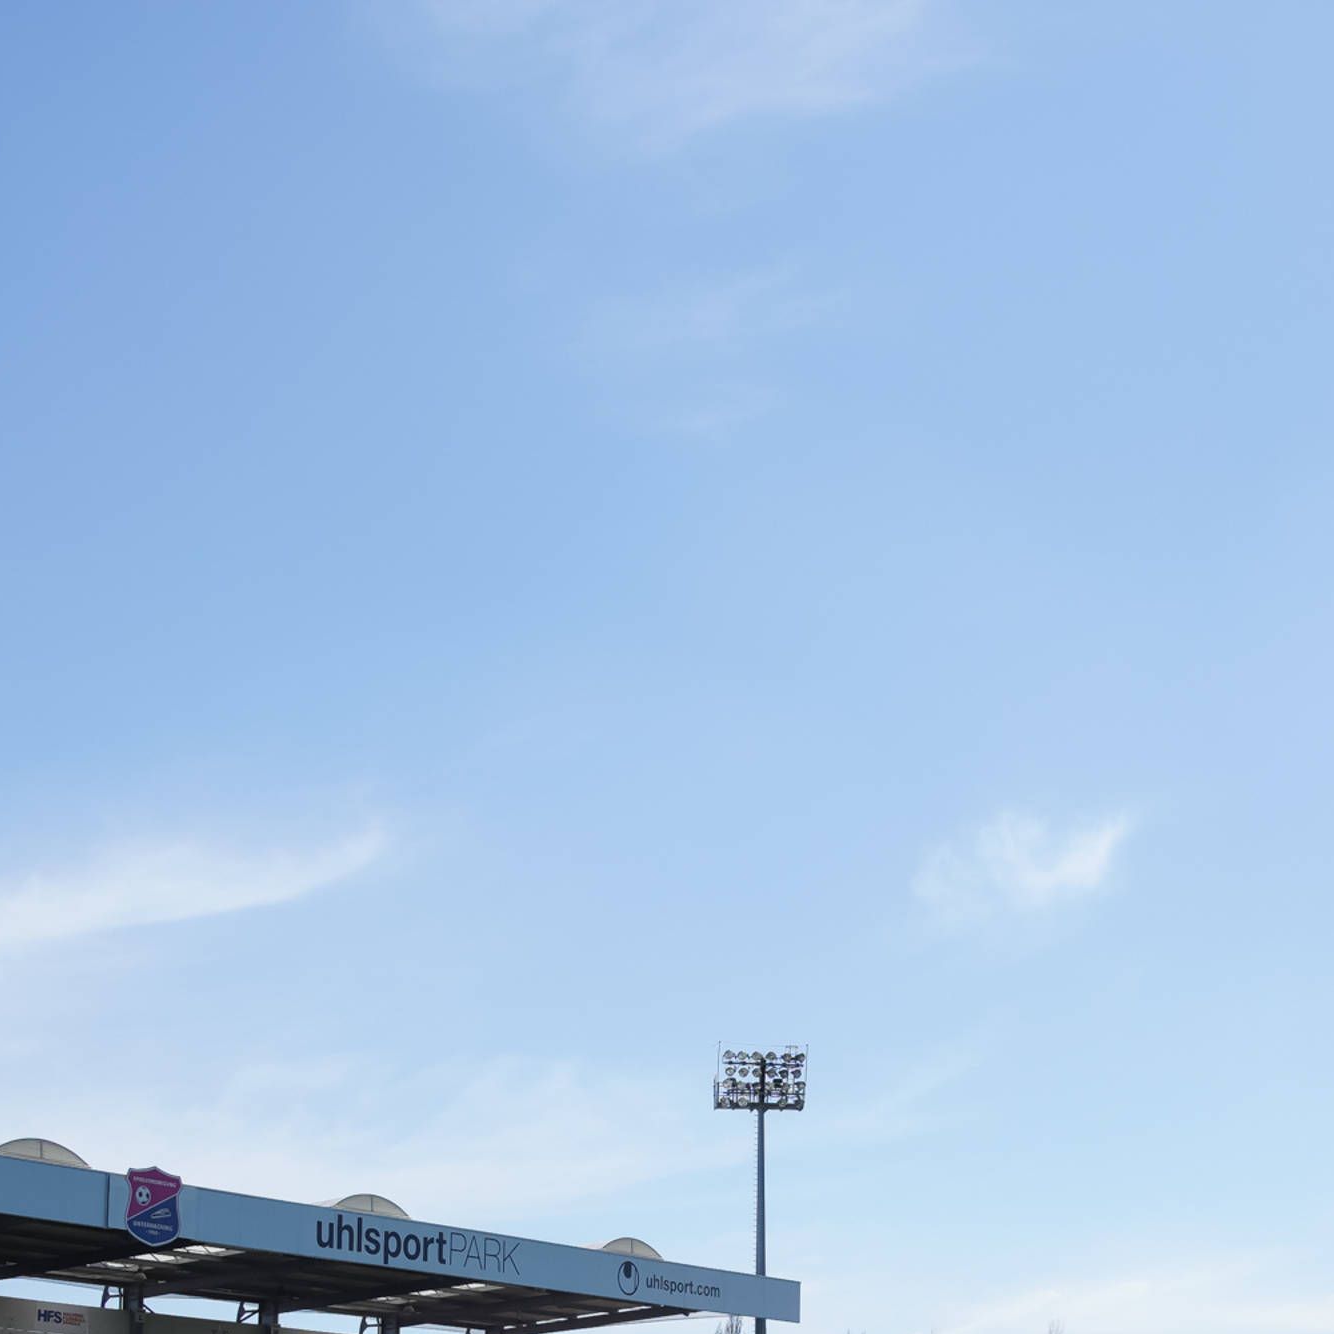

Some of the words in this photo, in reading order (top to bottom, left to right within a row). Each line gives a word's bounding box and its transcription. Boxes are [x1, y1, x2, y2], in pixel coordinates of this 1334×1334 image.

[317, 1214, 521, 1276] uhlsportPARK
[646, 1274, 721, 1298] uhlsport.com
[37, 1309, 63, 1324] HFS
